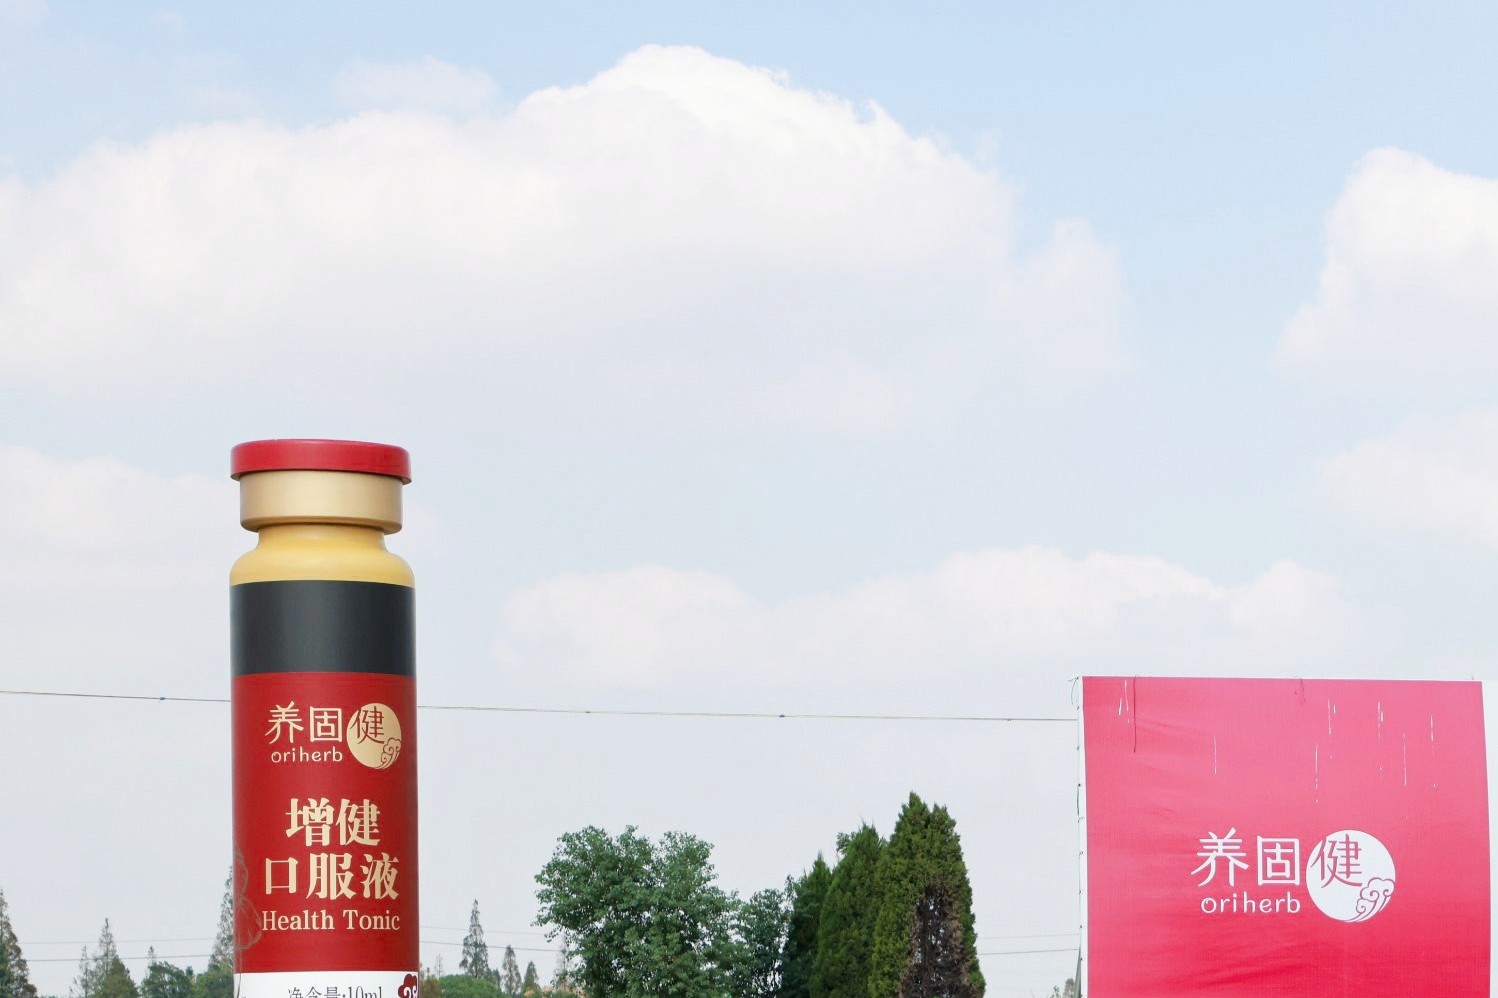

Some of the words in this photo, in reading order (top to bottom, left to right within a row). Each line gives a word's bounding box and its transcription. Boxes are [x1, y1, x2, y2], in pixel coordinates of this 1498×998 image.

[264, 700, 385, 745] 养固健
[270, 745, 343, 763] oriherb
[285, 797, 380, 847] 增健
[264, 852, 400, 900] 口服液
[1190, 827, 1364, 888] 养固健
[261, 908, 335, 932] Health
[342, 908, 401, 932] Tonic
[1200, 891, 1301, 915] oriherb
